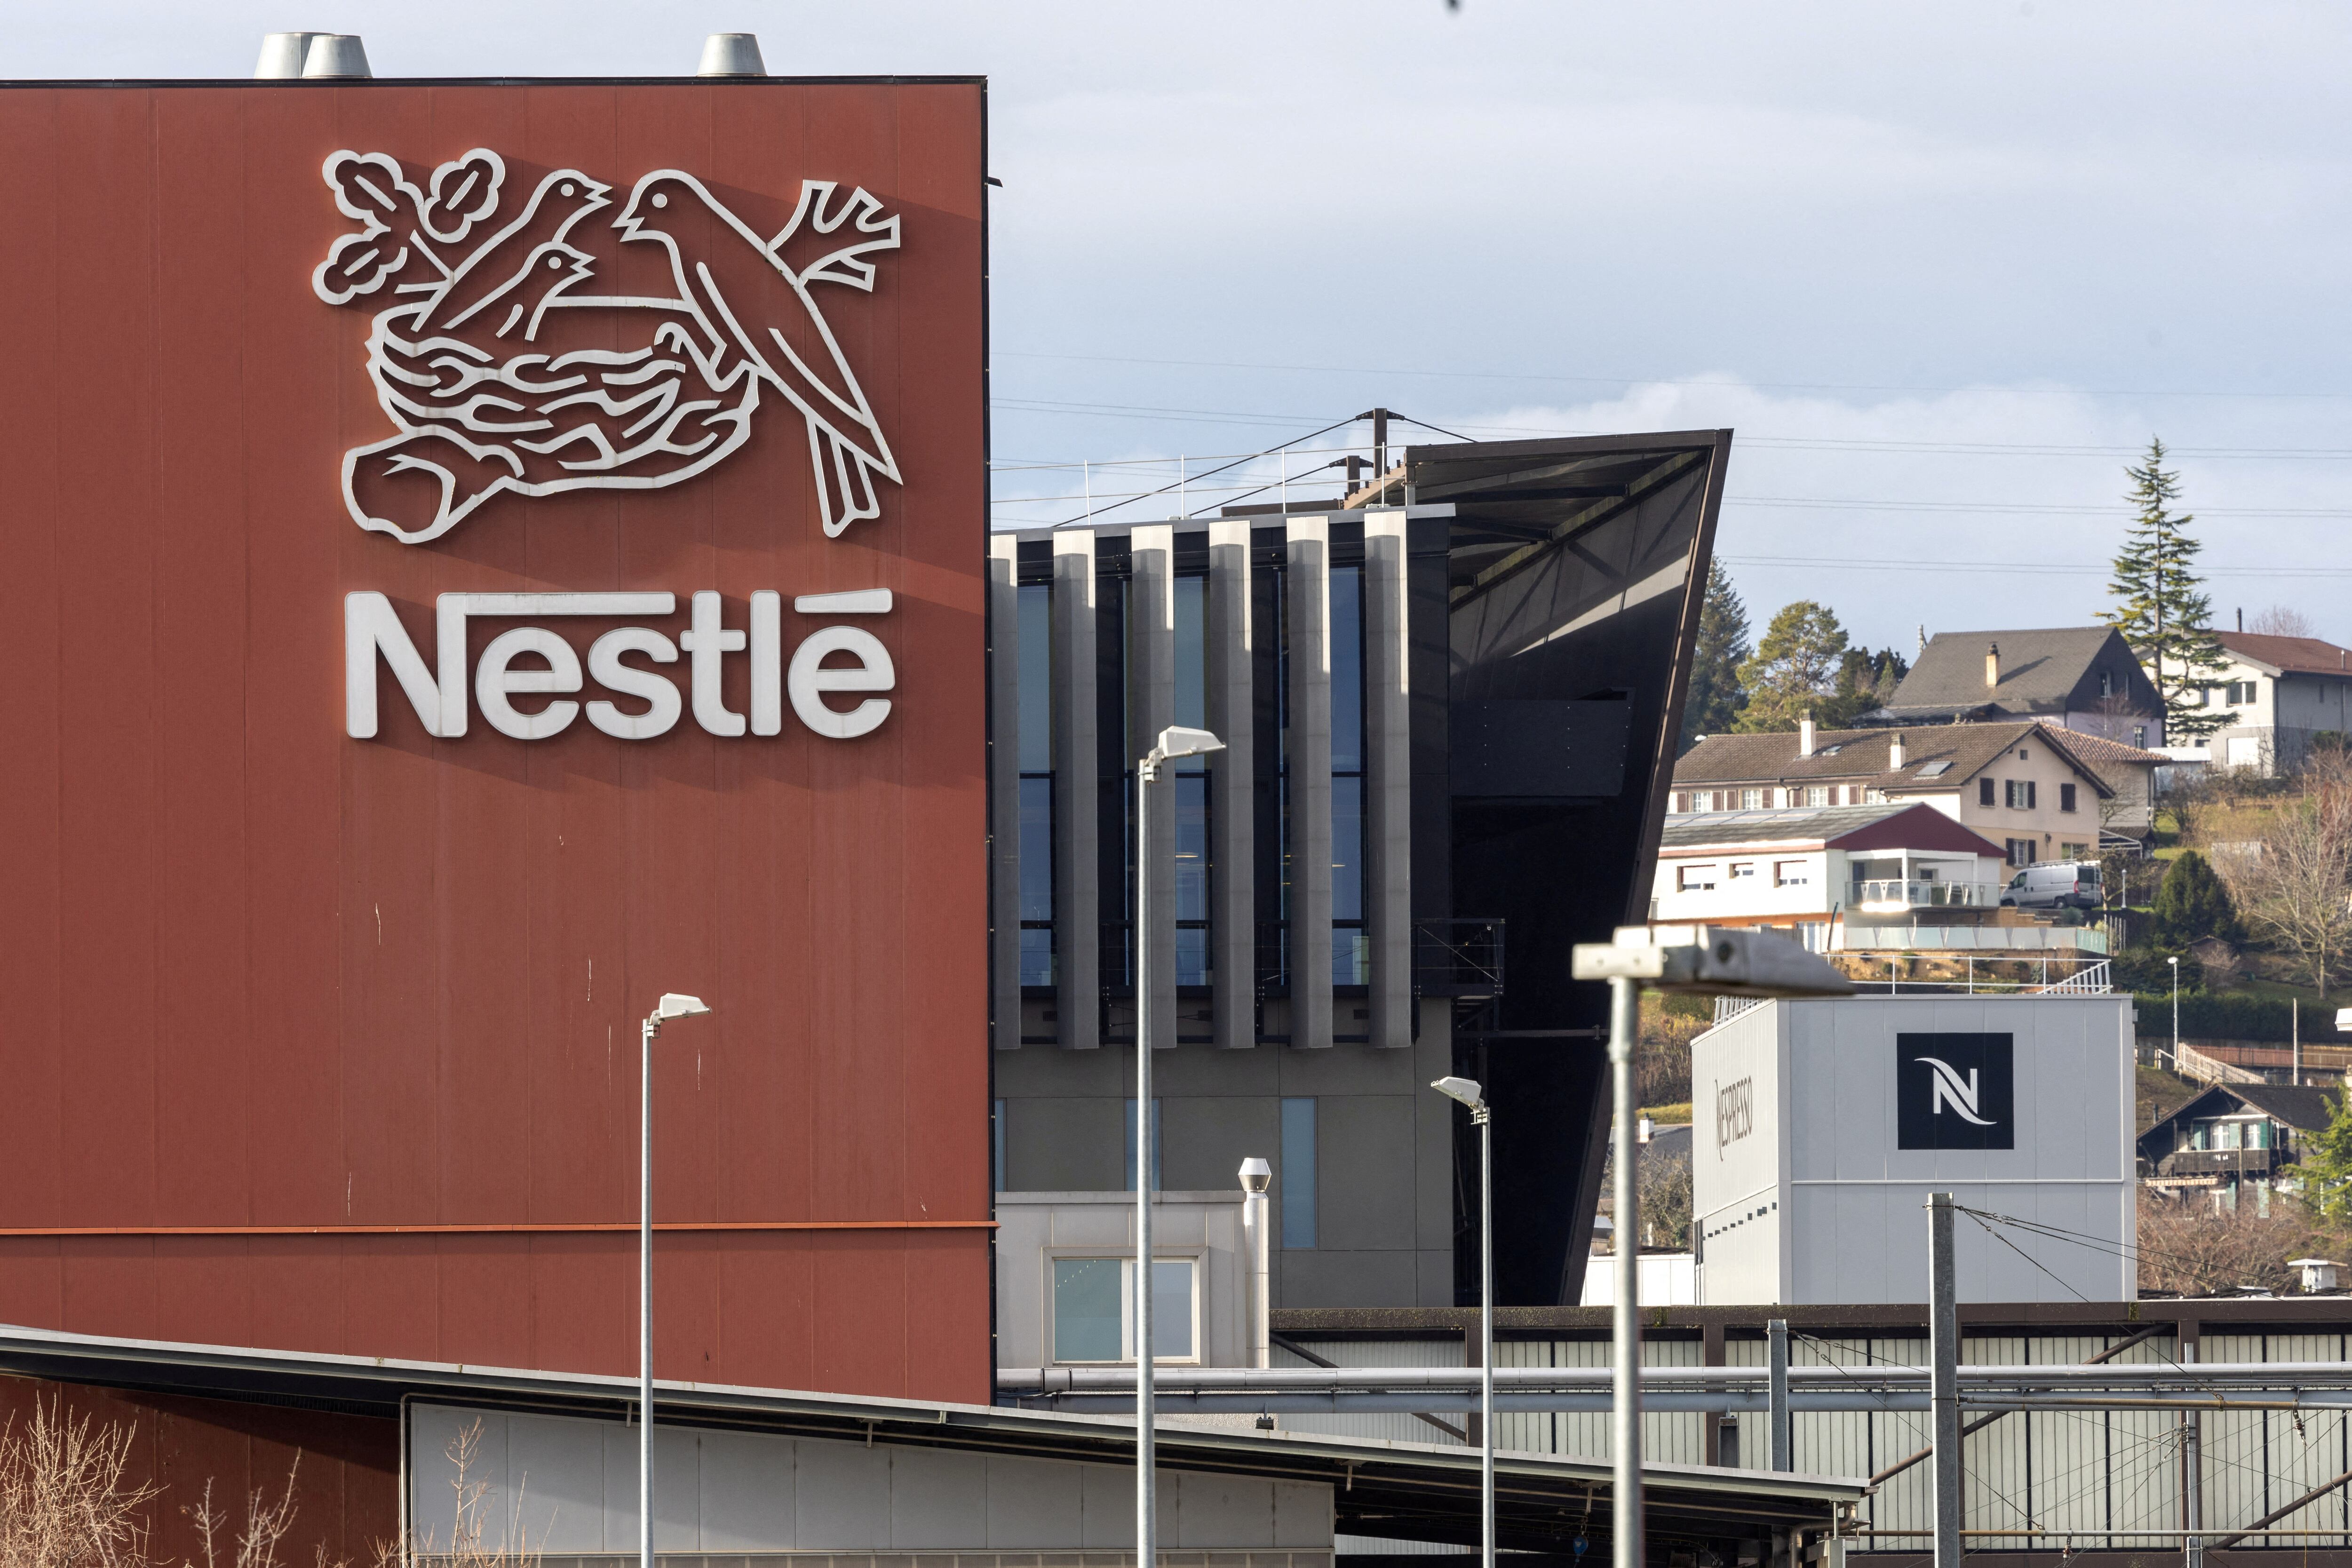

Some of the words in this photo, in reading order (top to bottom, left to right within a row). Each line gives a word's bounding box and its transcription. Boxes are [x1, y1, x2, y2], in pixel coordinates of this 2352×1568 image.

[345, 588, 895, 739] Nestlé
[1715, 1075, 1753, 1162] NESPRESSO
[1914, 1057, 1997, 1125] N
